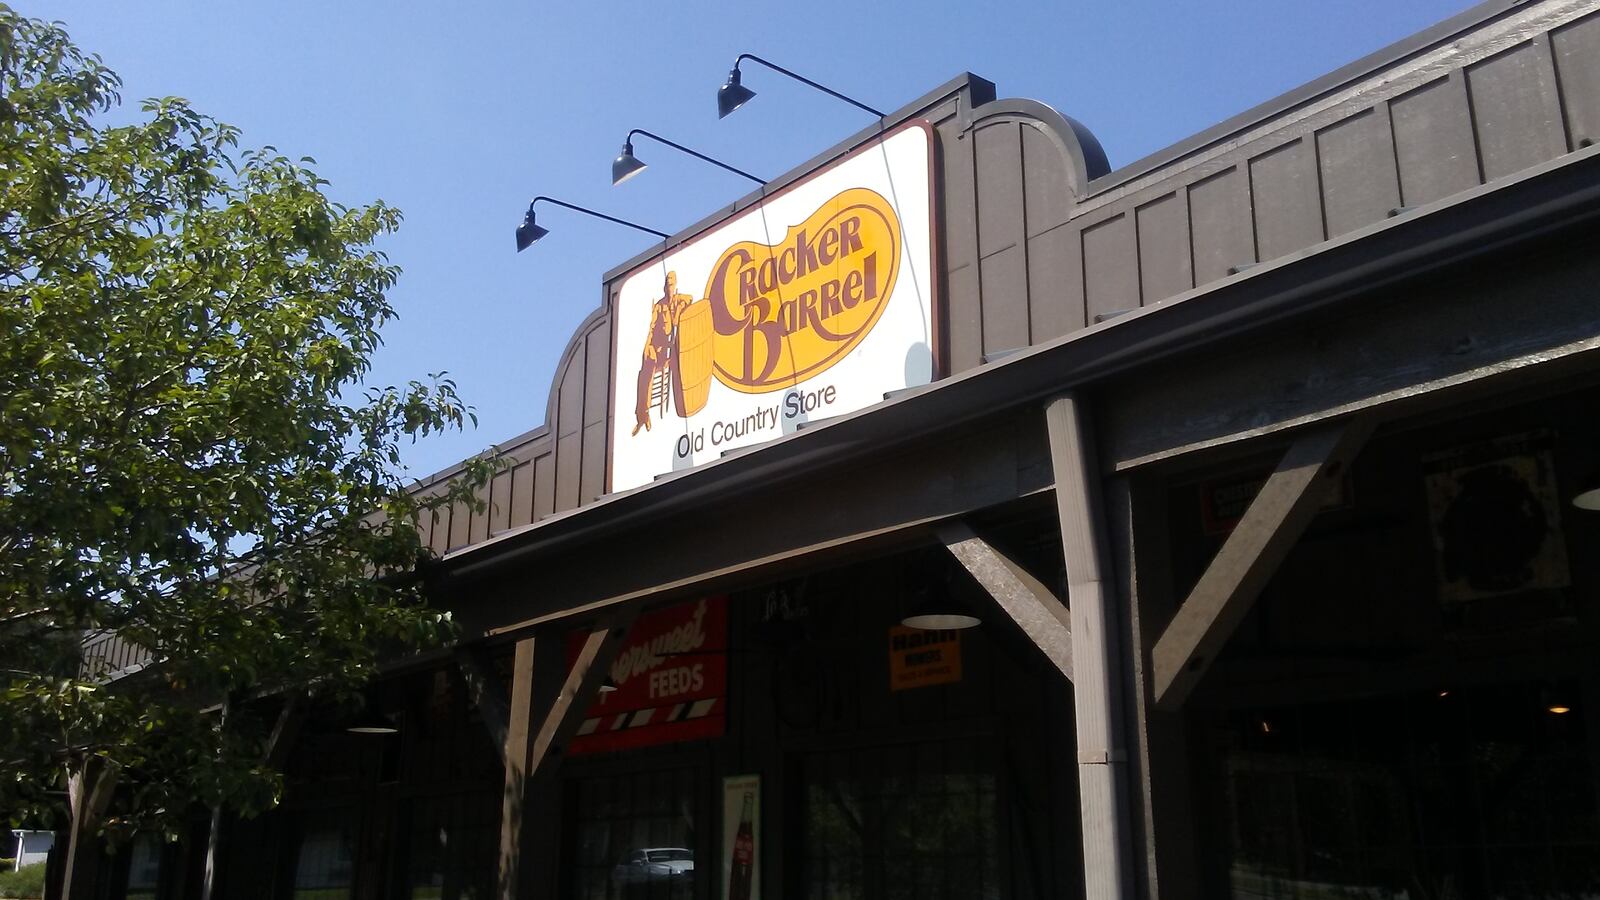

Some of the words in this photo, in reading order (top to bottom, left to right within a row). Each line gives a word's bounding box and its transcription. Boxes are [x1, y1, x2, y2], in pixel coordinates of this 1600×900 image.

[677, 427, 705, 459] Old
[711, 404, 780, 446] Country
[784, 384, 837, 419] Store
[649, 663, 704, 699] FEEDS
